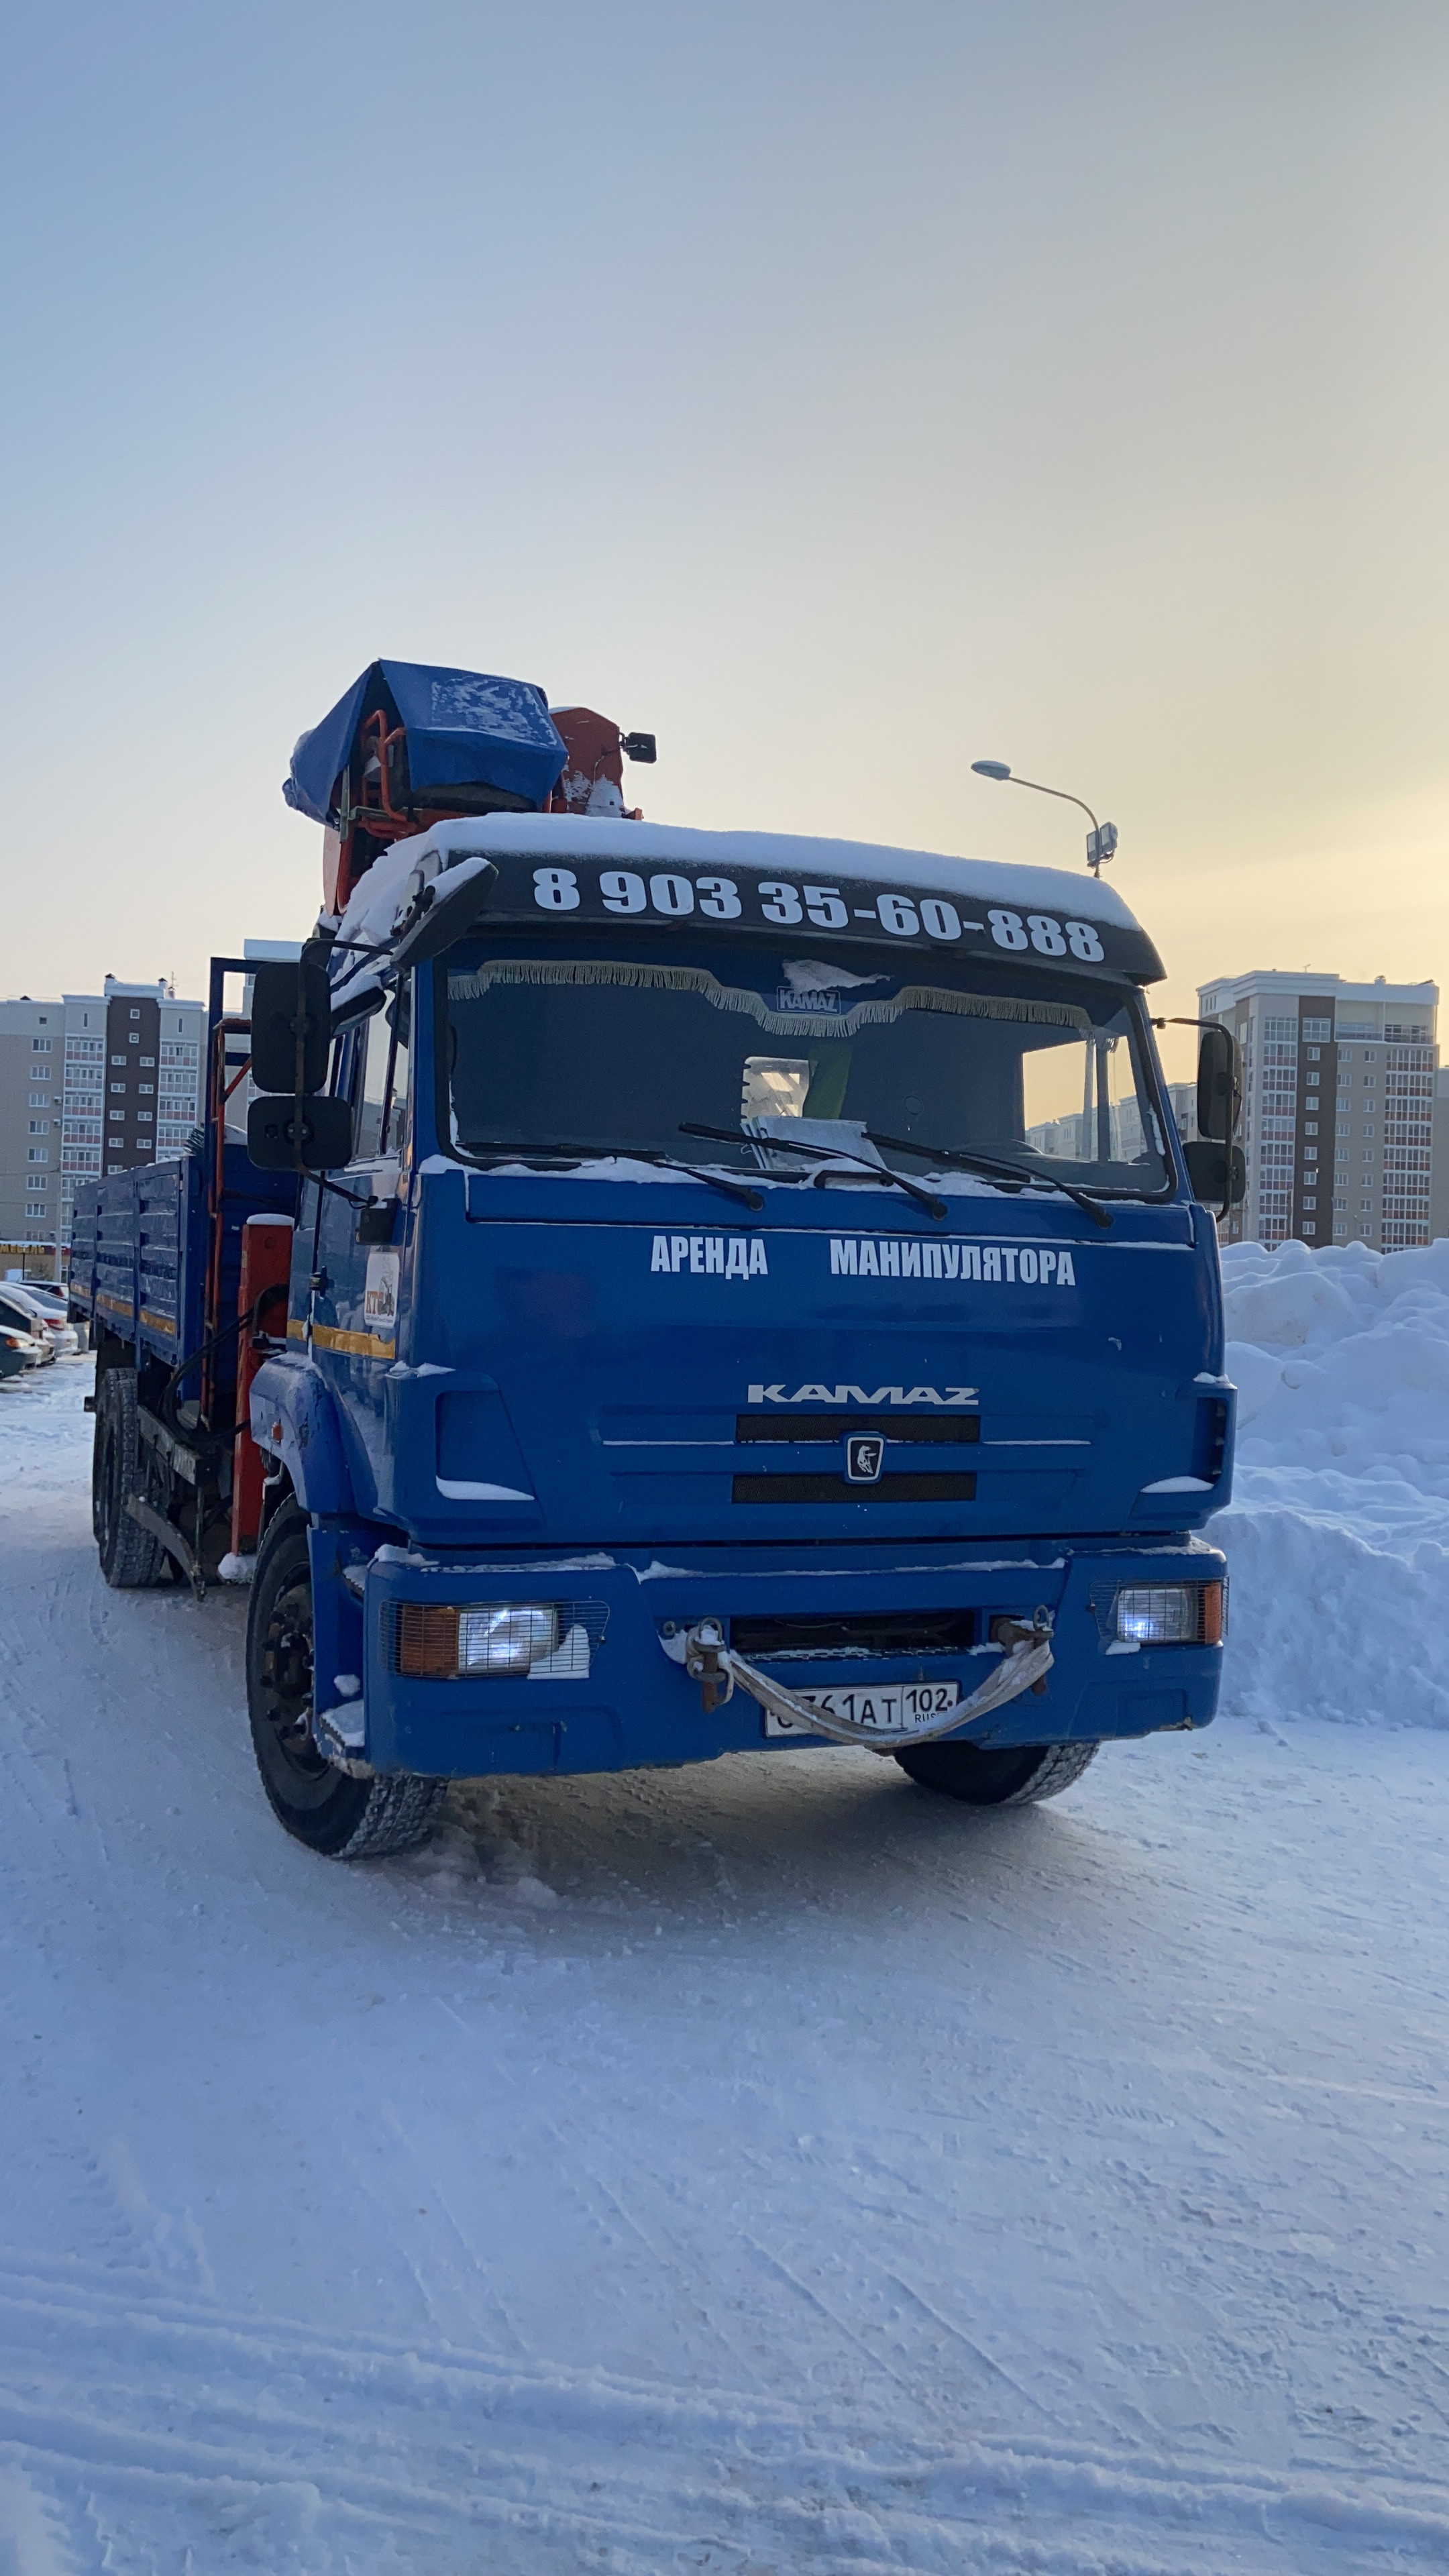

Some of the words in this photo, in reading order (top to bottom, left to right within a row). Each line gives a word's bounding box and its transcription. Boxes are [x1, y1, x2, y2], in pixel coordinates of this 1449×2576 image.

[533, 868, 580, 911] 8
[600, 871, 742, 918] 903
[759, 882, 1104, 962] 35-60-888
[780, 989, 838, 1012] KAMAZ
[651, 1235, 769, 1280] АРЕНДА
[830, 1239, 1076, 1286] МАНИПУЛЯТОРА
[747, 1384, 979, 1405] KAMAZ
[906, 1688, 949, 1714] 102
